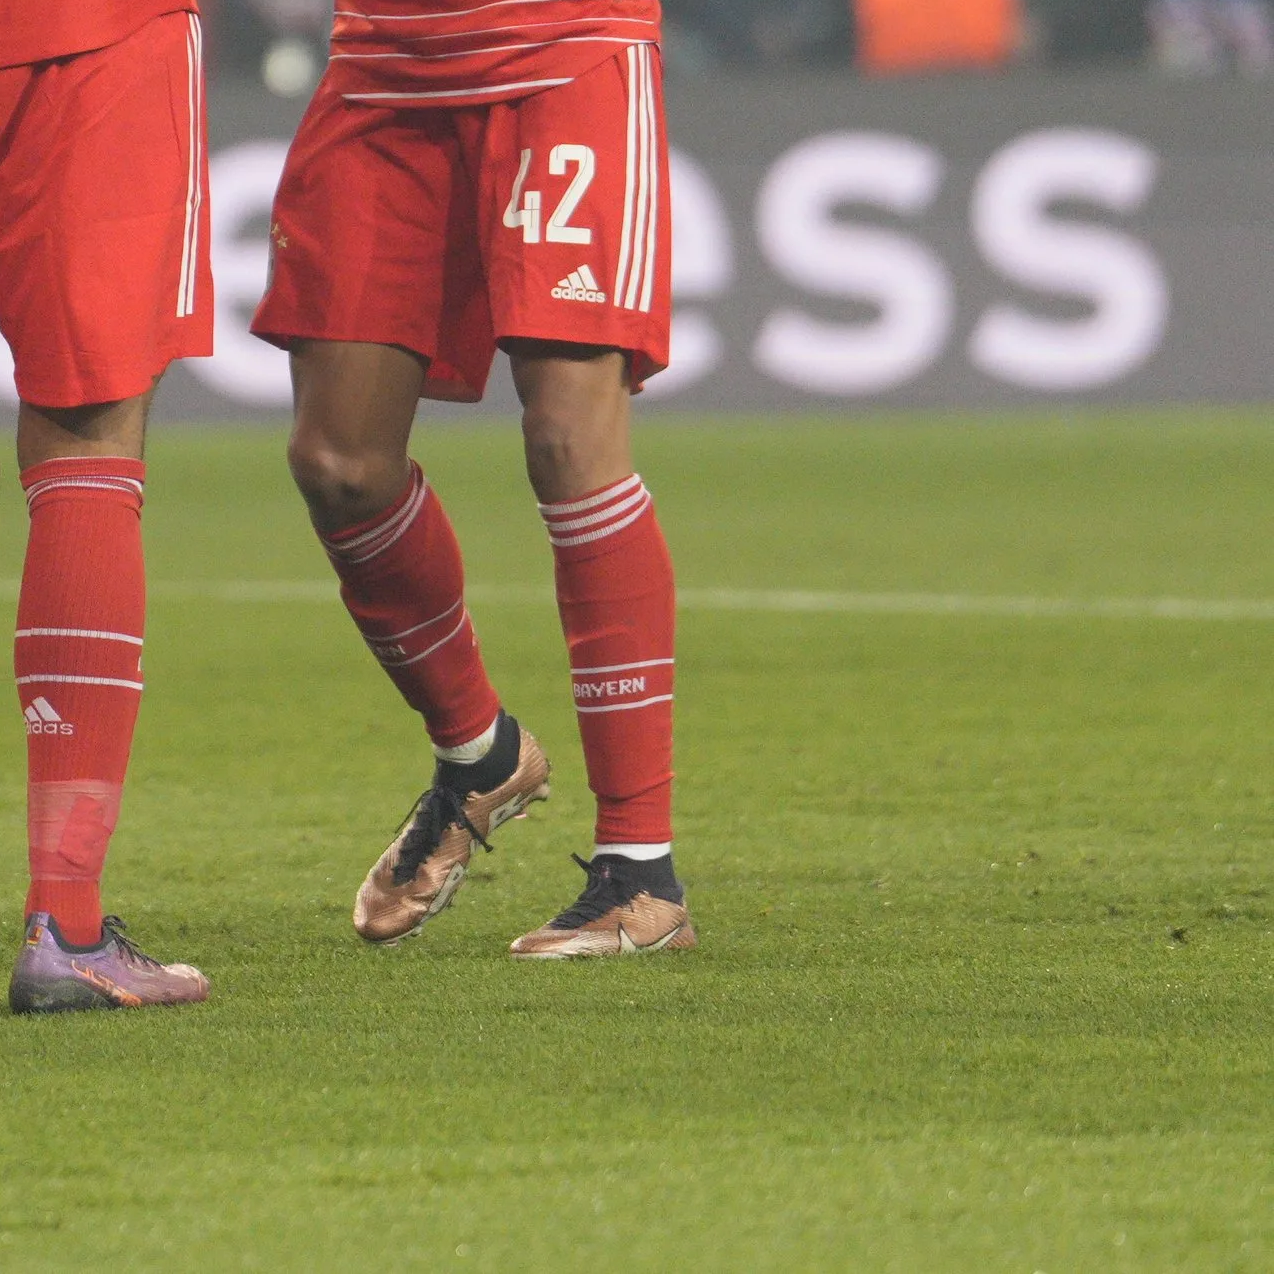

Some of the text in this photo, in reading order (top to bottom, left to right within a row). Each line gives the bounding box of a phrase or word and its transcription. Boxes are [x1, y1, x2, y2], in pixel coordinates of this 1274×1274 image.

[502, 143, 595, 245] 42
[550, 286, 607, 303] adidas
[573, 676, 646, 698] BAYERN
